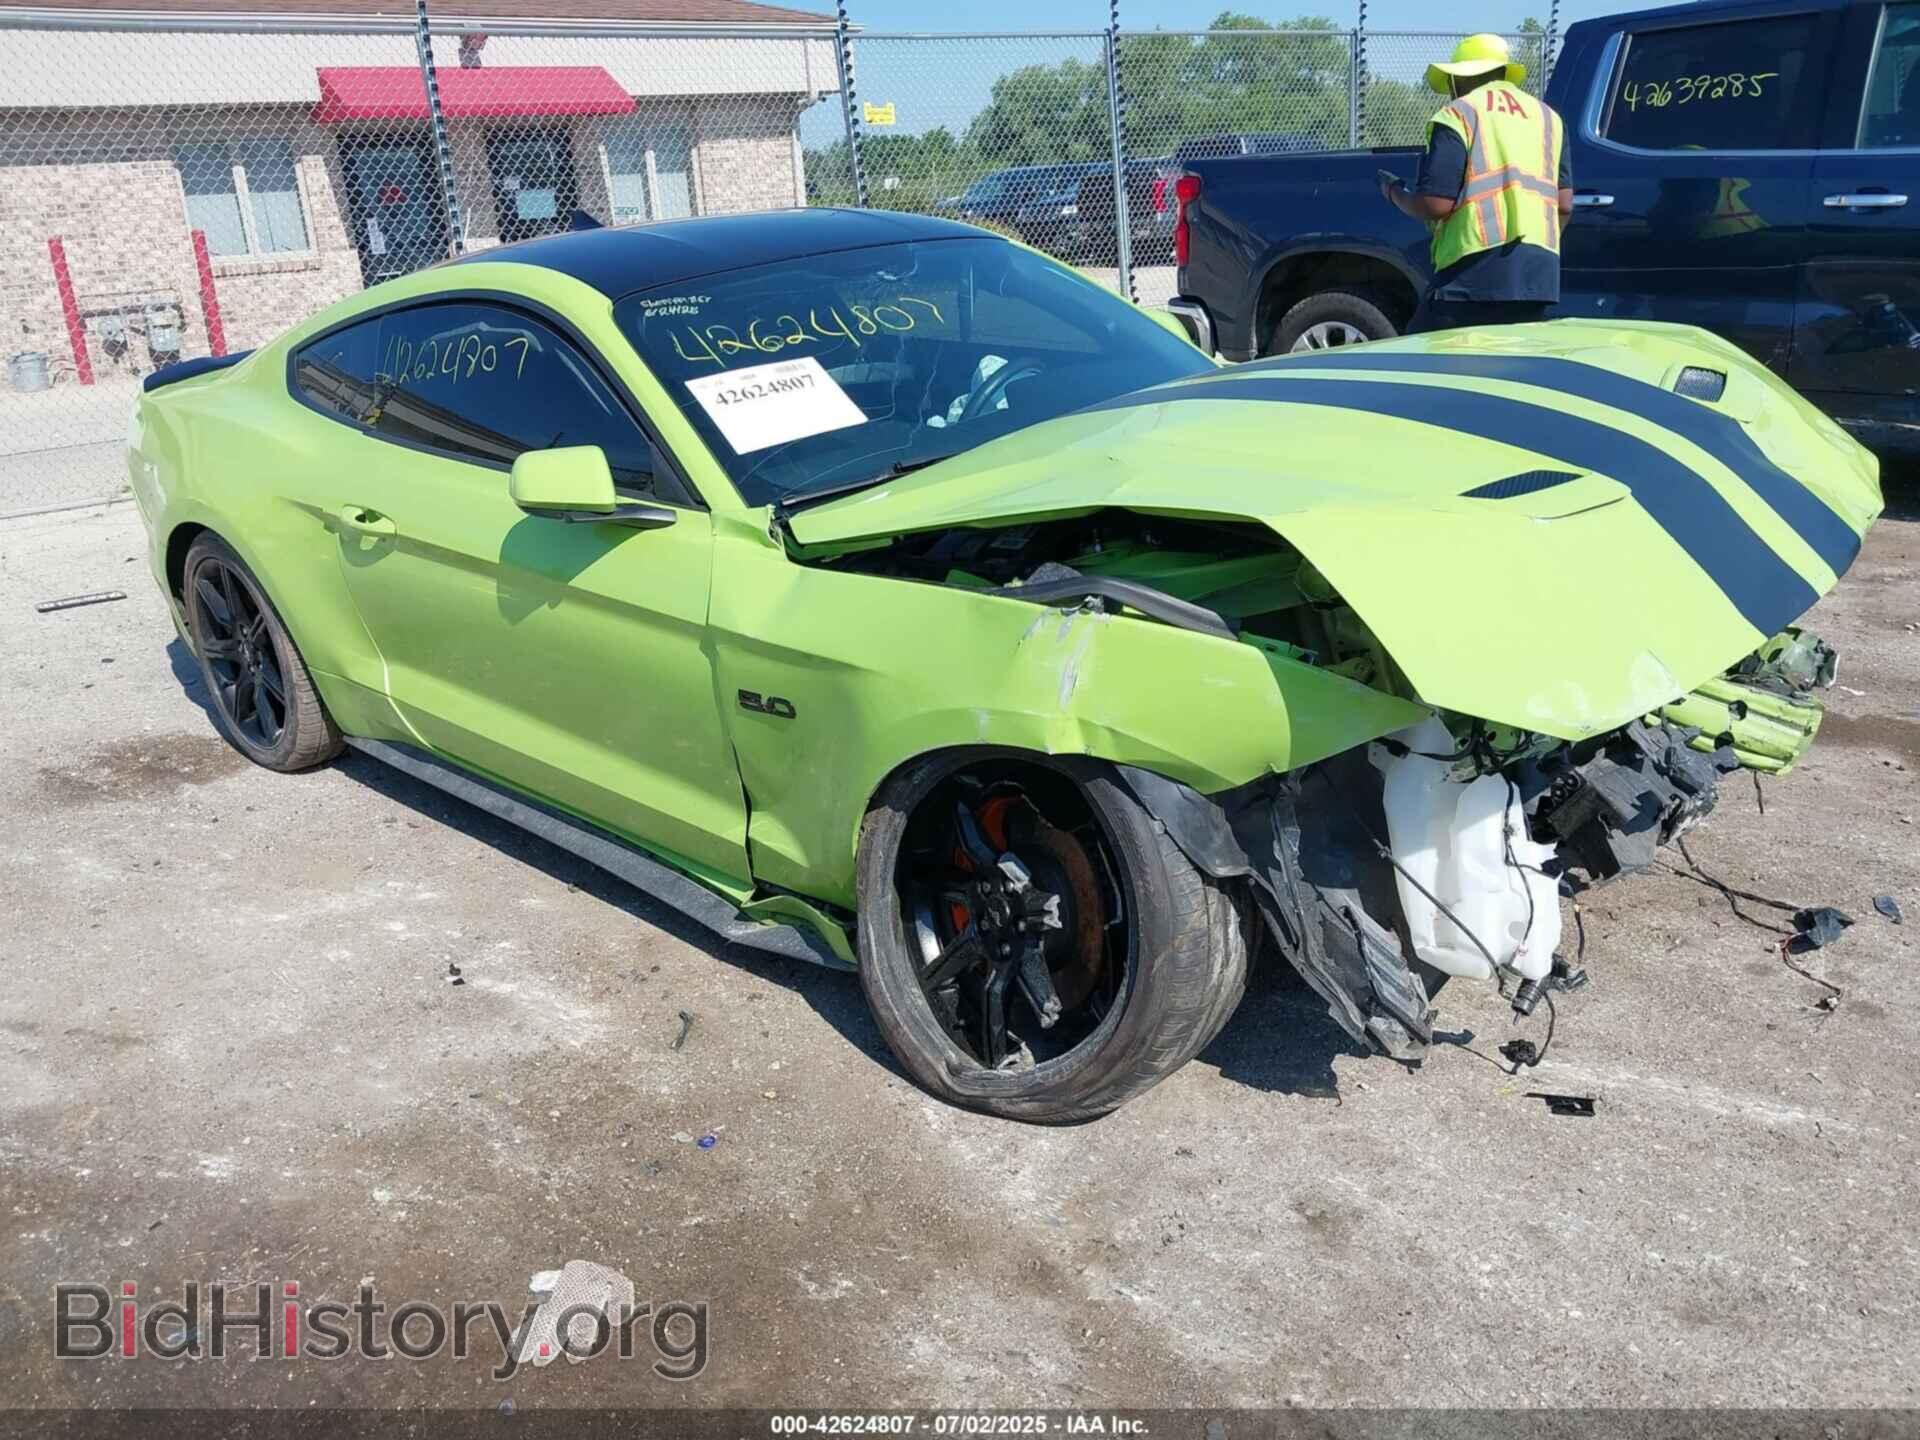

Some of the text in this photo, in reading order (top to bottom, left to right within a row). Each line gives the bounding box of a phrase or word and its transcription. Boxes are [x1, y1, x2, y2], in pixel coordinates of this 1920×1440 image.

[1623, 73, 1779, 112] 42639285
[667, 297, 944, 368] 42624807
[383, 334, 529, 385] 42624807
[715, 373, 816, 406] 42624807
